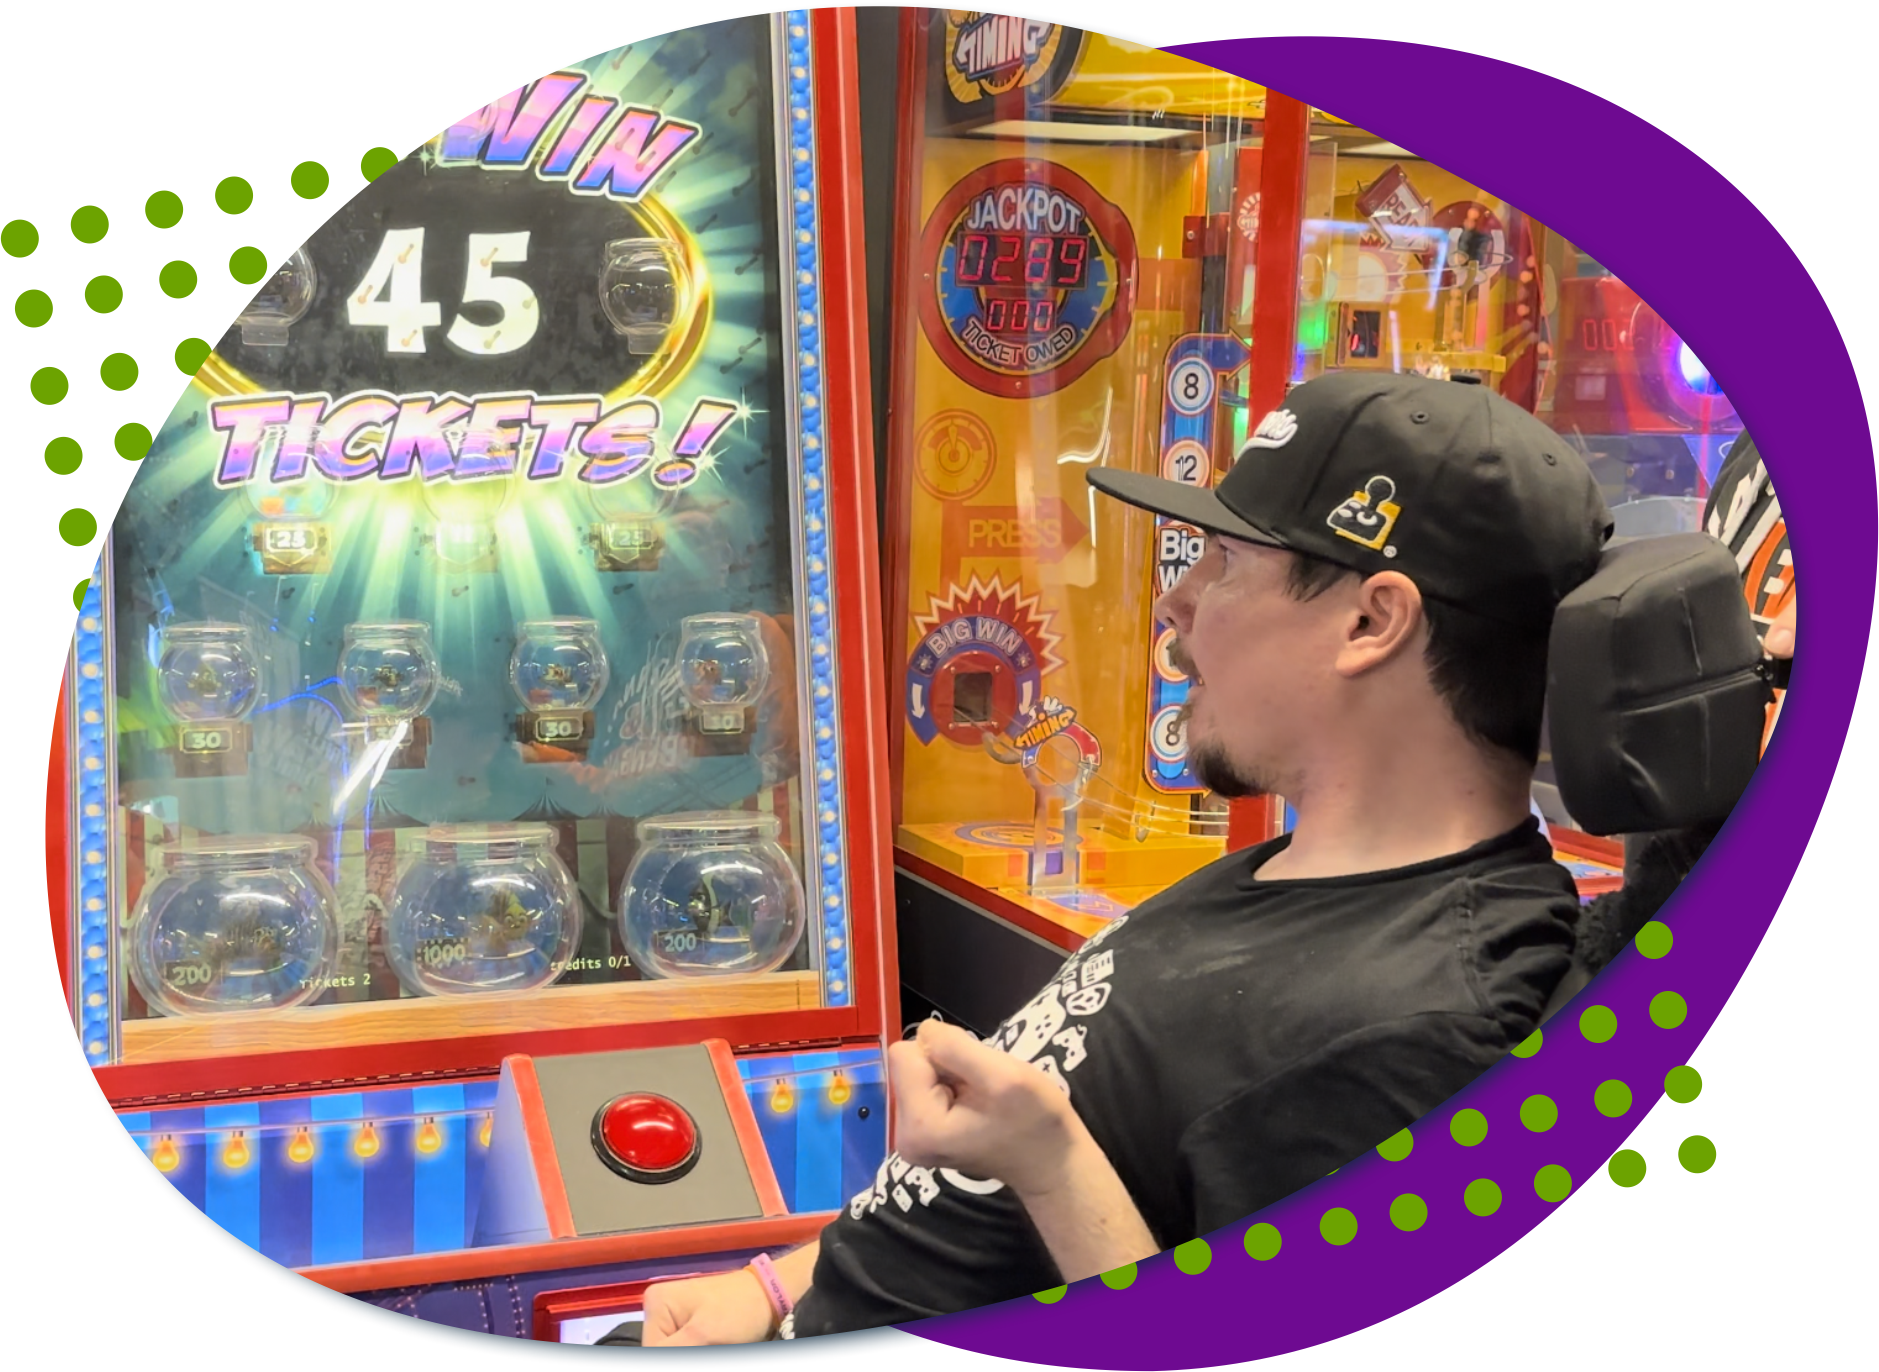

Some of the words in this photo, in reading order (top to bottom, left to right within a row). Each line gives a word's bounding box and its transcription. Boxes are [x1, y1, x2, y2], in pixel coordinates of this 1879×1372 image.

[956, 14, 1051, 73] TIMING
[438, 71, 699, 200] WIN
[967, 188, 1081, 234] JACKPOT
[958, 235, 1086, 284] 0289
[347, 226, 540, 355] 45
[987, 301, 1053, 332] 000
[965, 320, 1022, 364] TICKET
[1026, 327, 1074, 363] OWED
[1183, 372, 1199, 400] 8
[211, 395, 740, 486] TICKETS!
[1175, 455, 1198, 482] 12
[276, 531, 306, 548] 25
[968, 518, 1062, 549] PRESS
[1159, 528, 1205, 565] Big
[929, 621, 971, 654] BIG
[978, 619, 1021, 654] WIN
[192, 731, 222, 749] 30
[545, 721, 572, 737] 30
[424, 944, 467, 965] 1000
[664, 933, 697, 952] 200
[172, 963, 212, 986] 200
[608, 955, 631, 969] 0/1
[363, 973, 371, 985] 2
